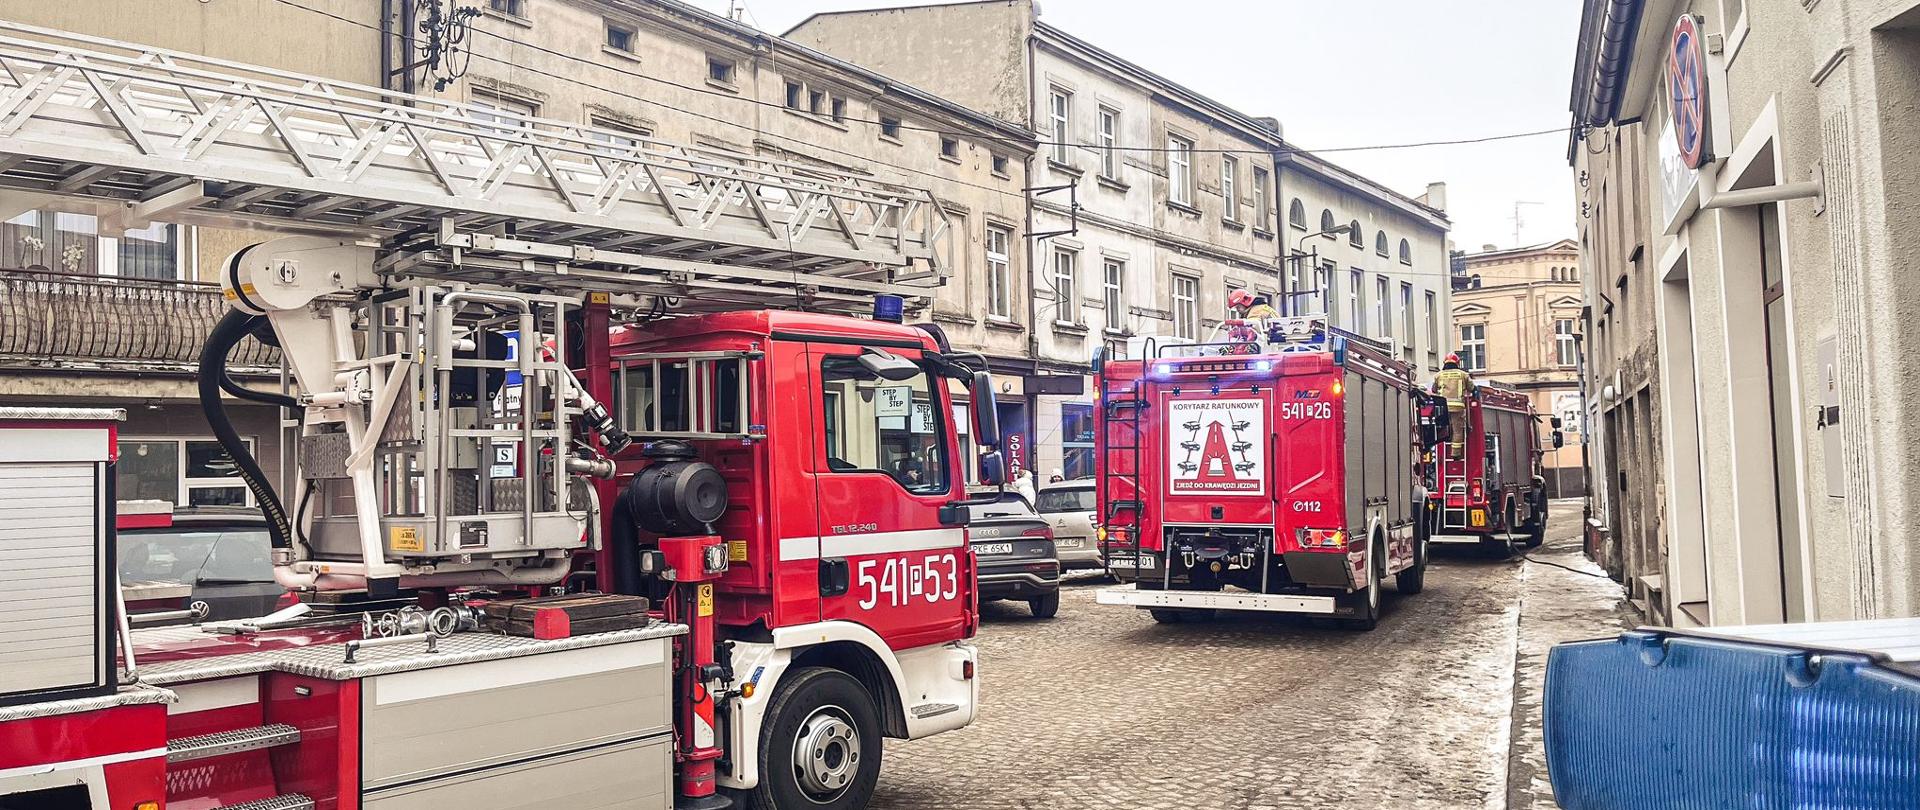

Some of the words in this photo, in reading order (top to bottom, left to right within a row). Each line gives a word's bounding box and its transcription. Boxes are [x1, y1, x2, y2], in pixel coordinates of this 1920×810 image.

[498, 394, 521, 405] Patny
[916, 404, 931, 414] STEP
[1173, 403, 1210, 411] KORYTARZ
[1211, 402, 1260, 410] RATUNKOWY
[923, 413, 931, 422] BY
[923, 422, 934, 432] STE
[501, 449, 509, 461] S
[1304, 501, 1321, 512] 112
